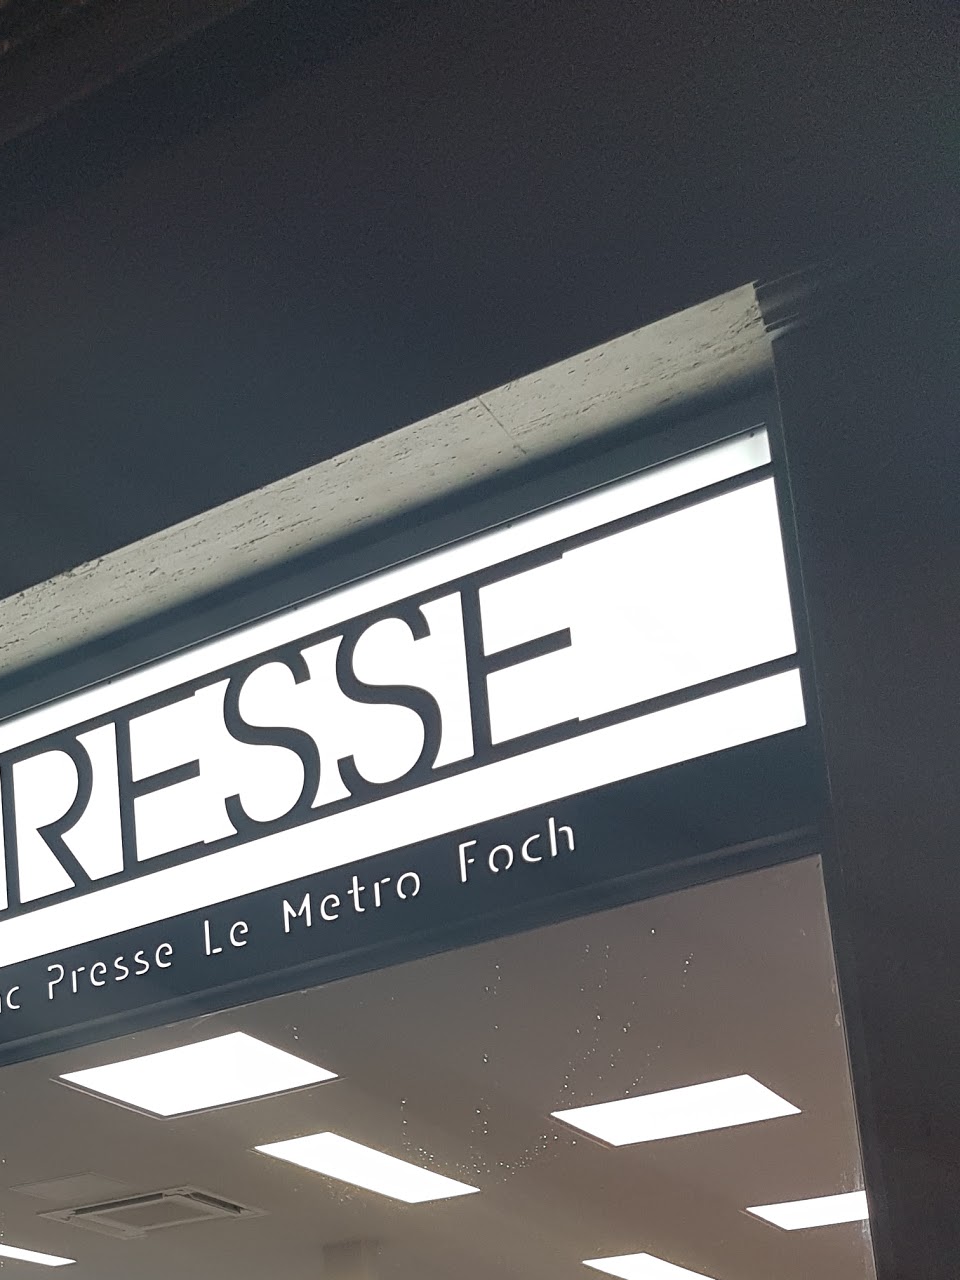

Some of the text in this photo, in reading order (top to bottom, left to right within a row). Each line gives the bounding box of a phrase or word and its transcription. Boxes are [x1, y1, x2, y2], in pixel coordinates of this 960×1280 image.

[47, 941, 174, 1000] Presse
[204, 918, 249, 956] Le
[283, 872, 421, 934] Metro
[457, 816, 575, 883] Foch
